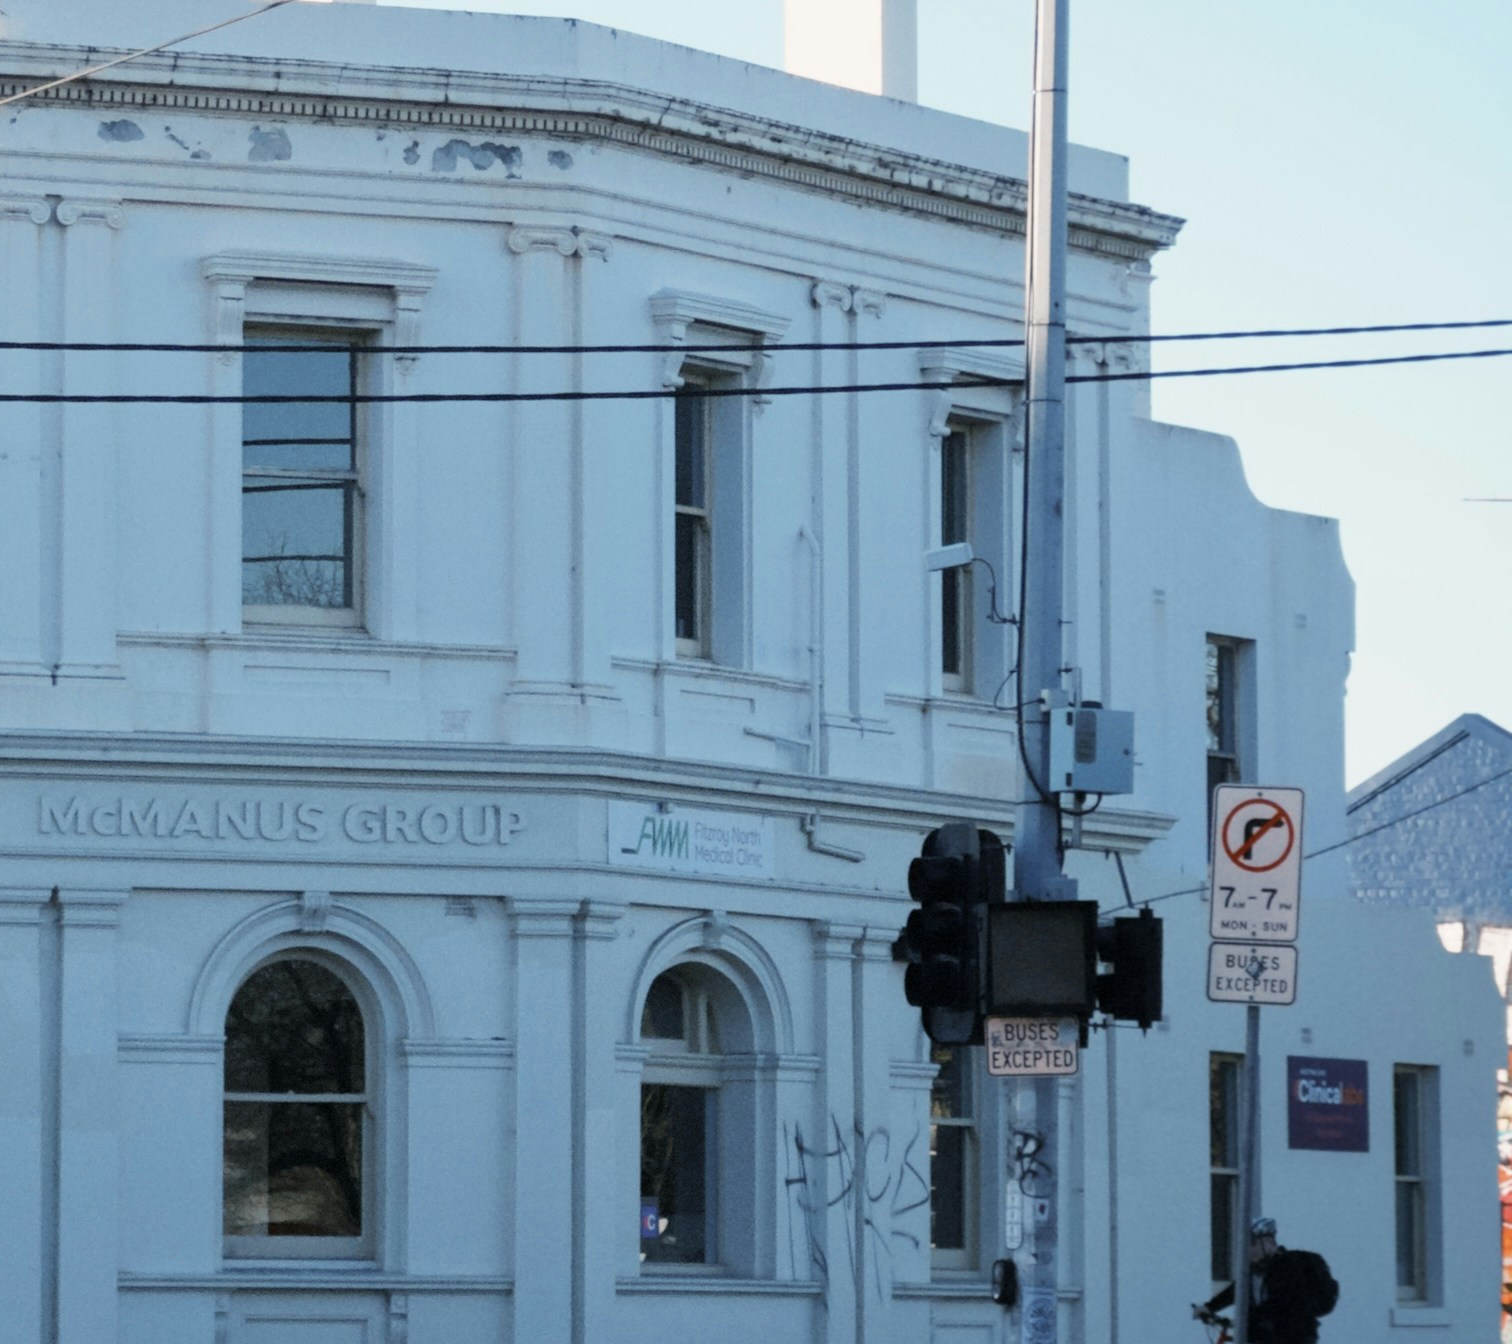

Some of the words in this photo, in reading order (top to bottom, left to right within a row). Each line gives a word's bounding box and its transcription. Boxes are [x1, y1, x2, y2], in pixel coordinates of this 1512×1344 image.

[37, 794, 327, 842] McMANUS
[341, 802, 529, 846] GROUP
[694, 822, 730, 845] Fitzroy
[731, 826, 761, 846] North
[694, 844, 734, 866] Medical
[736, 847, 764, 868] Clinic
[1220, 920, 1248, 931] MON
[1263, 922, 1287, 932] SUN
[1215, 976, 1287, 994] EXCEPTED
[1004, 1023, 1059, 1042] BUSES
[992, 1050, 1074, 1070] EXCEPTED
